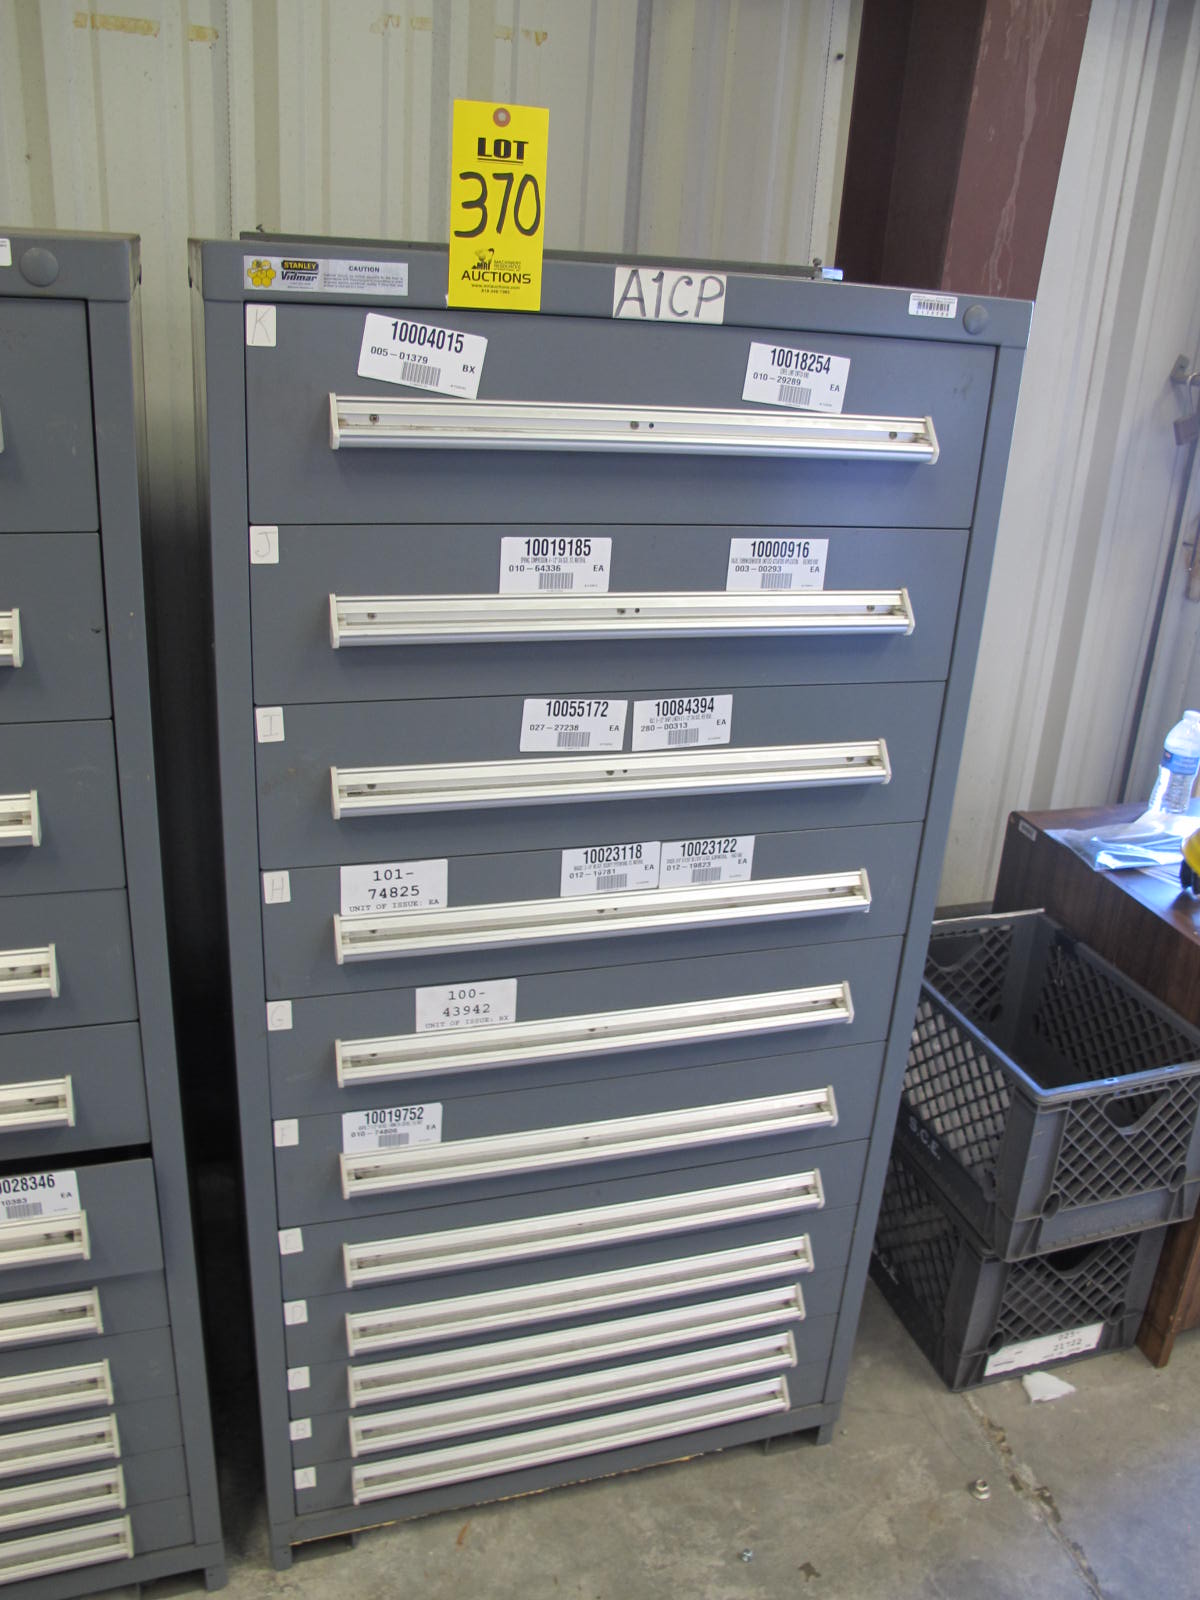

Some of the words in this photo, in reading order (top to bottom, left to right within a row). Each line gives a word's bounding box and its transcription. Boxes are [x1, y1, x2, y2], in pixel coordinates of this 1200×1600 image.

[477, 137, 529, 160] LOT
[454, 172, 541, 238] 370
[284, 260, 317, 270] STANLEY
[349, 265, 380, 273] CAUTION
[281, 270, 318, 282] Vidmar
[461, 270, 531, 284] AUCTIONS
[613, 268, 725, 318] A1CP
[252, 307, 272, 344] K
[391, 321, 465, 353] 10004015
[462, 364, 476, 374] BX
[771, 348, 832, 375] 10018254
[829, 384, 840, 392] EA
[254, 531, 277, 557] J
[525, 538, 592, 557] 10019185
[751, 541, 810, 558] 10000916
[593, 564, 604, 572] EA
[546, 701, 610, 718] 10055172
[655, 697, 715, 716] 10084394
[609, 724, 620, 732] EA
[582, 844, 643, 865] 10023118
[680, 838, 738, 857] 10023122
[373, 868, 414, 881] 101-
[644, 863, 655, 871] EA
[270, 876, 284, 901] H
[367, 885, 421, 900] 74825
[442, 1003, 491, 1017] 43942
[364, 1106, 424, 1125] 10019752
